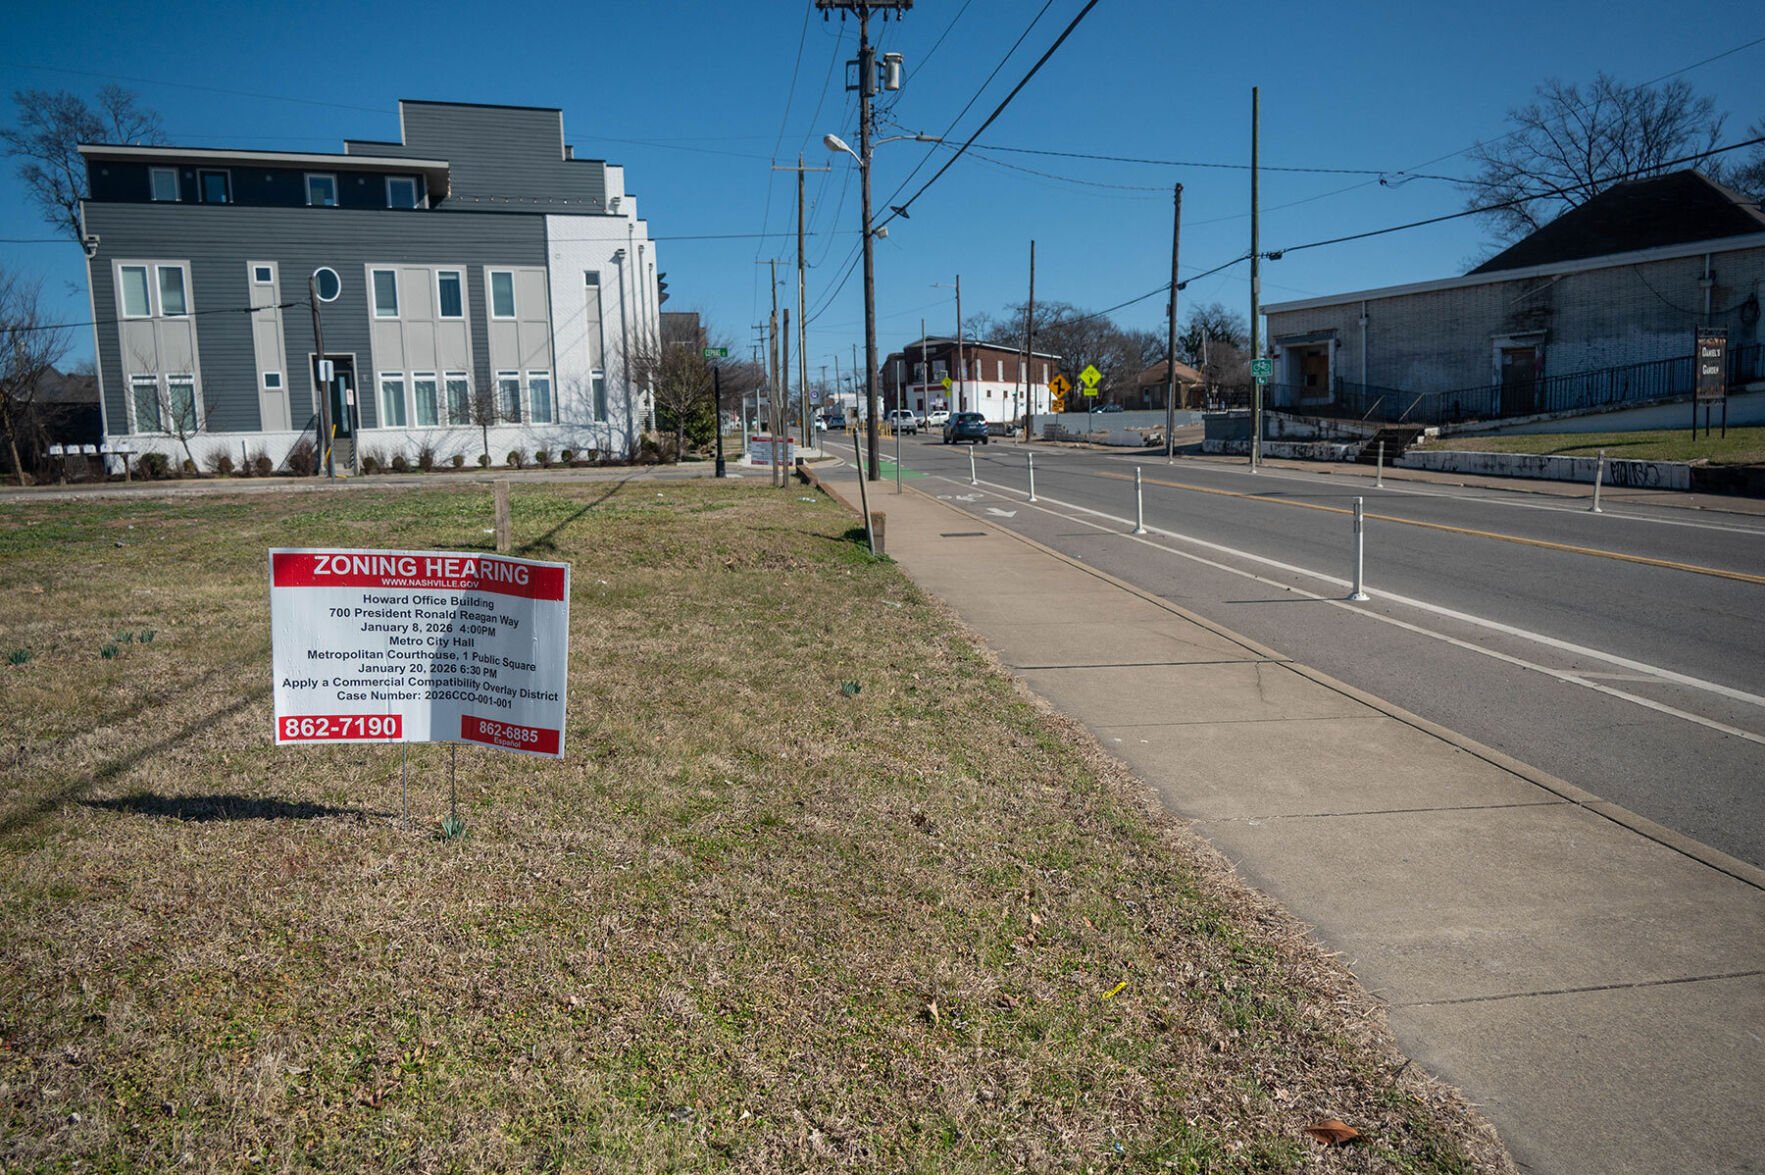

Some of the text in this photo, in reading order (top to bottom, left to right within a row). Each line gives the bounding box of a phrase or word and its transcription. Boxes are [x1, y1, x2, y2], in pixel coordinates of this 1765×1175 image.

[1053, 400, 1062, 408] 25
[314, 556, 529, 586] ZONING HEARING
[382, 578, 480, 588] WWW.NASHVILLE.GOV
[363, 594, 494, 611] Howard Office Building
[330, 608, 520, 629] 700 President Ronald Reagan Way
[361, 622, 496, 637] January 8, 2026 4:00PM
[389, 636, 474, 648] Metro City Hall
[308, 650, 536, 672] Metropolitan Courthouse, 1 Public Square
[358, 664, 498, 679] January 20, 2026 6:30 PM
[282, 677, 558, 702] Apply a Commercial Compatibility Overlay District
[336, 690, 512, 709] Case Number: 2026CCO-001-001
[285, 716, 396, 738] 862-7190
[479, 720, 538, 743] 862-6885
[494, 736, 521, 748] Español
